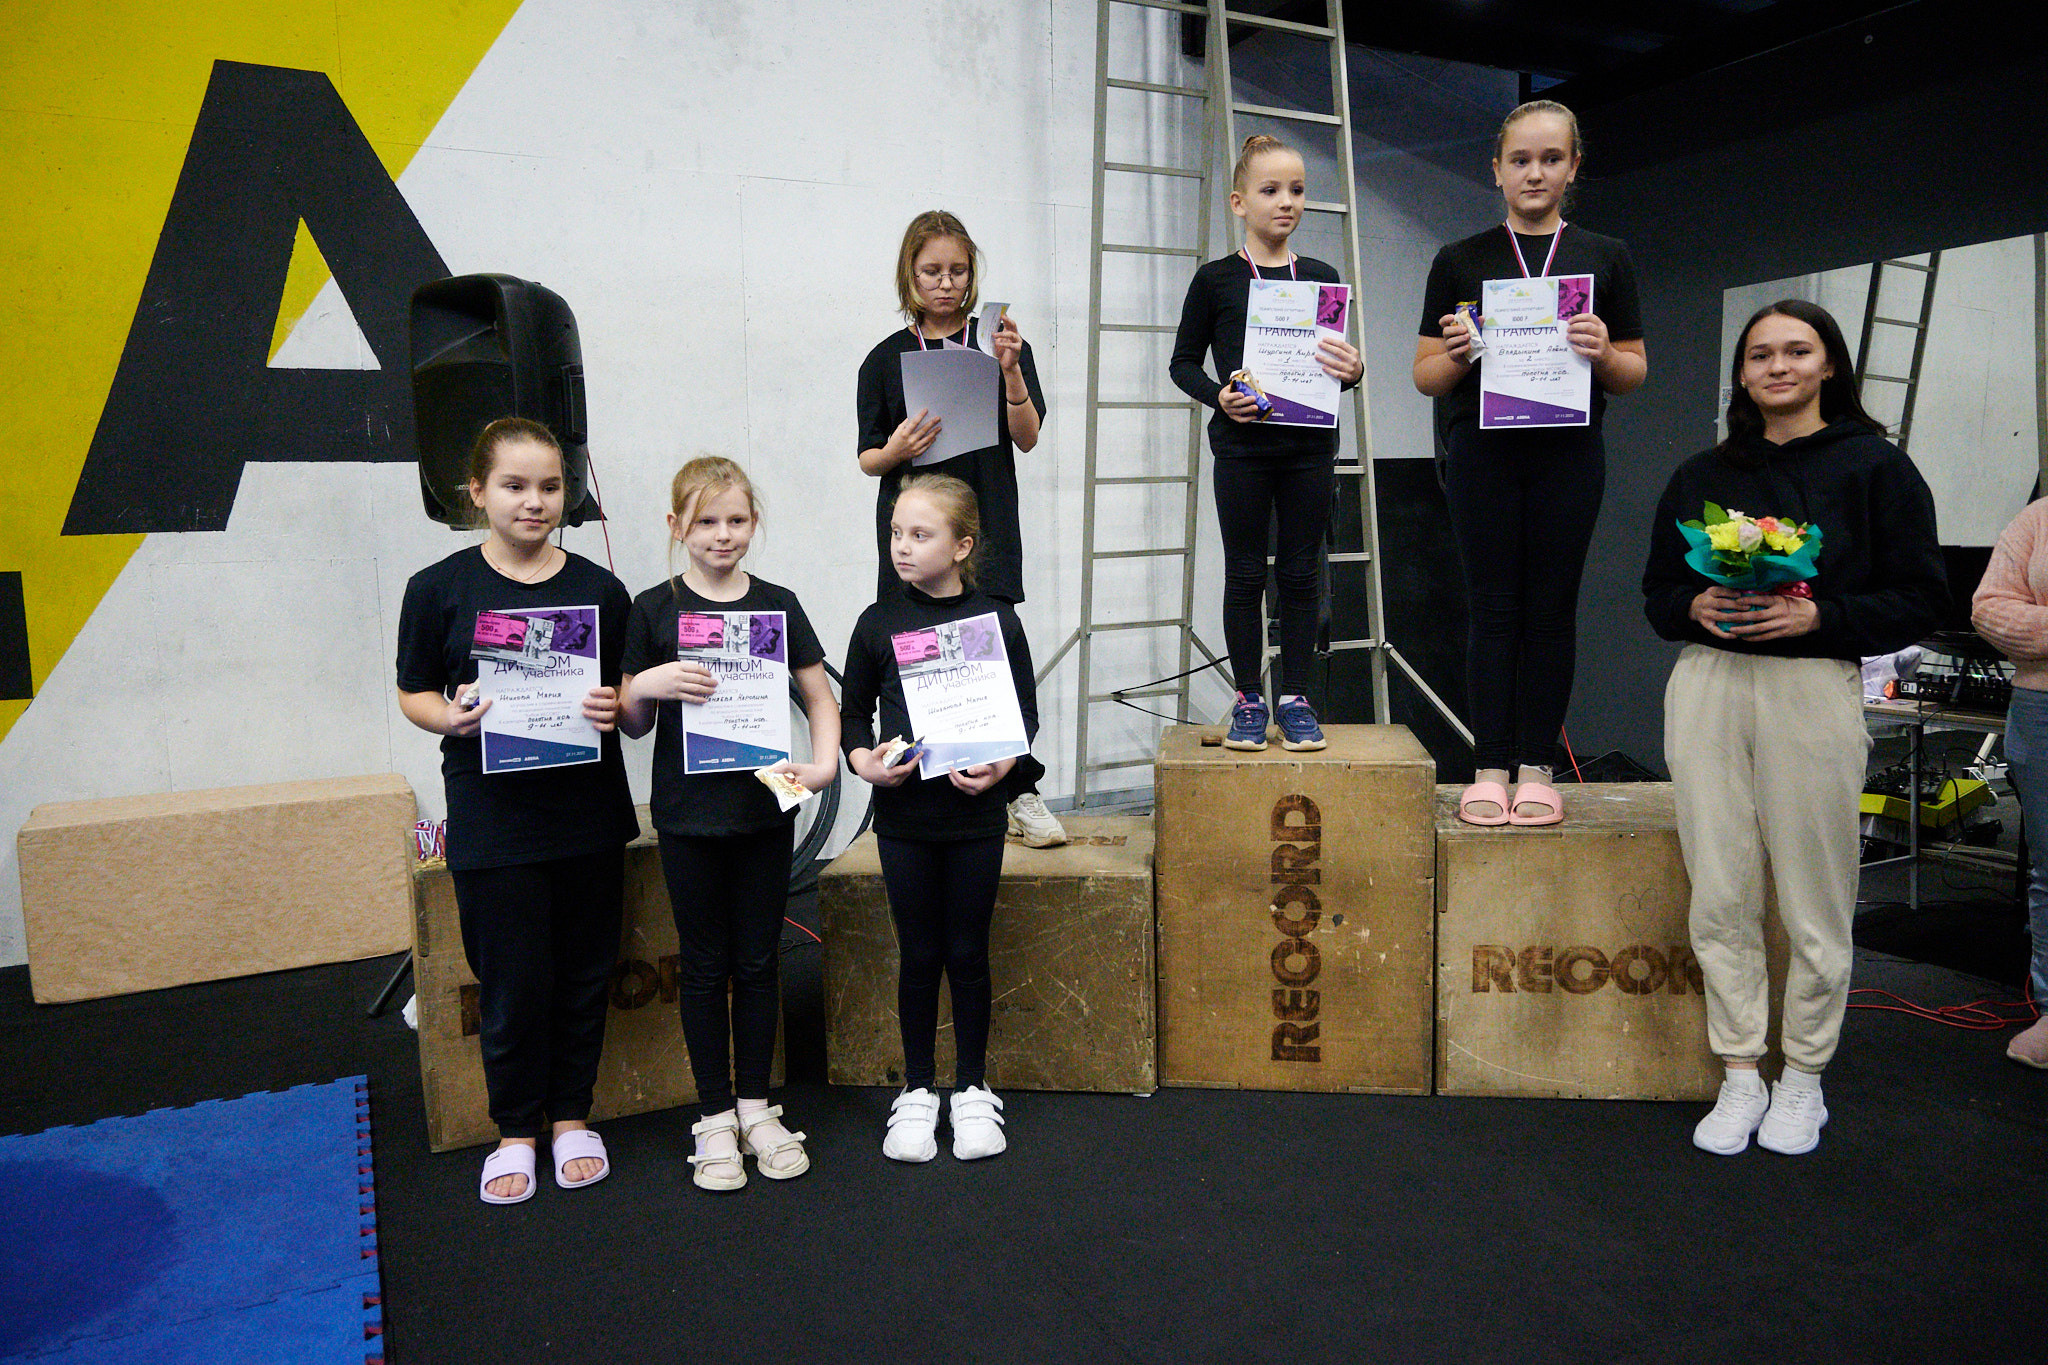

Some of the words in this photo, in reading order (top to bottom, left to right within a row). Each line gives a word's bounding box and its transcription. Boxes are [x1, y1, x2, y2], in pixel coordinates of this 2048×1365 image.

[523, 667, 584, 681] участника
[720, 672, 774, 683] участника
[942, 671, 996, 693] участника
[1271, 794, 1322, 1063] RECORD
[1472, 944, 1705, 996] RECOR
